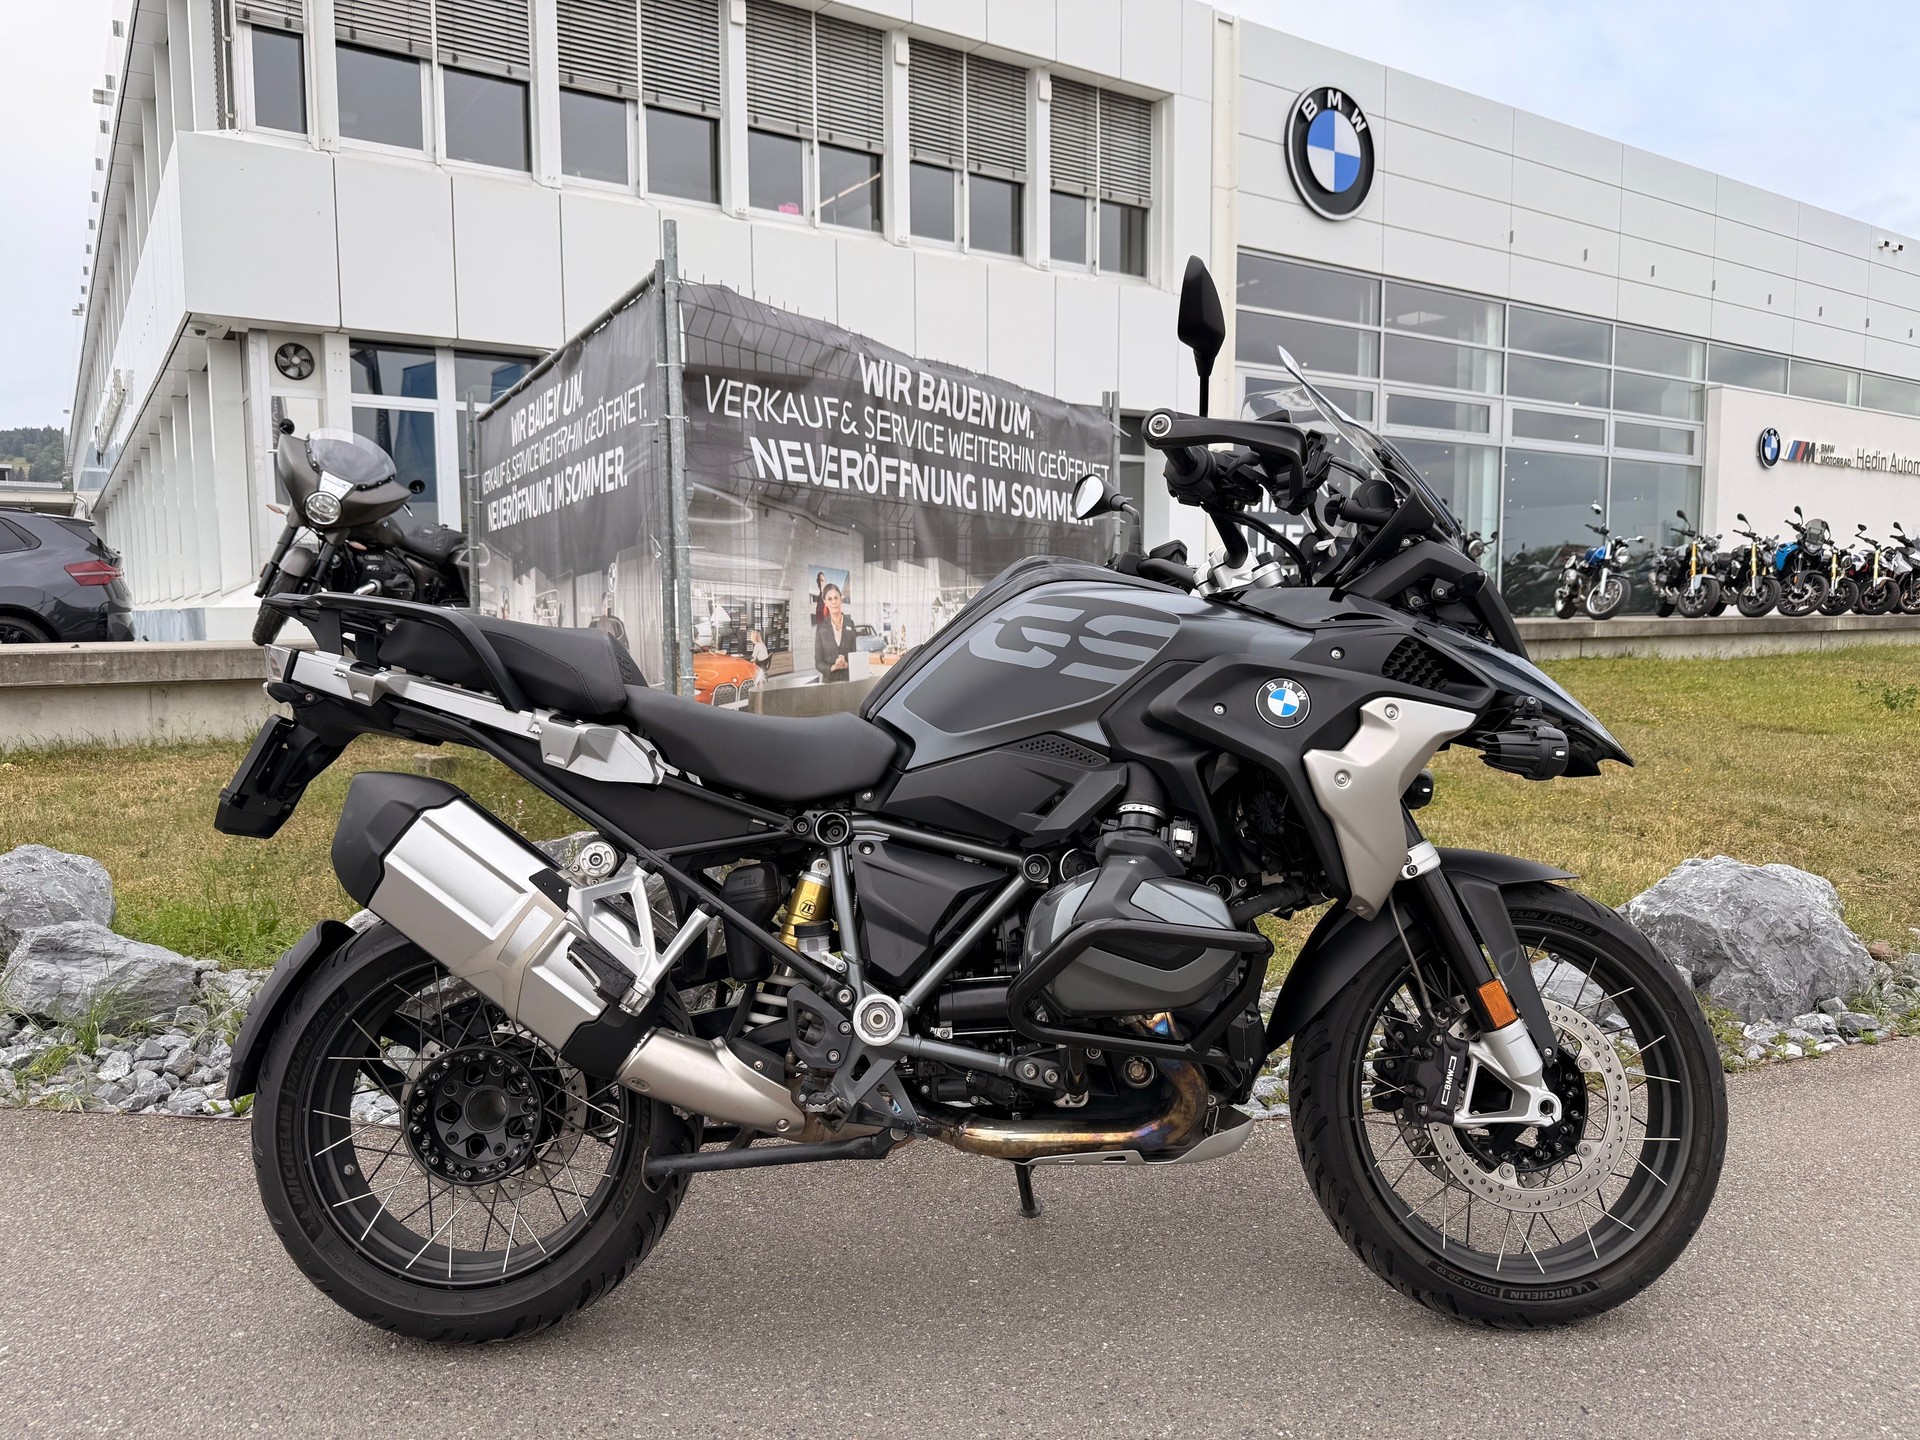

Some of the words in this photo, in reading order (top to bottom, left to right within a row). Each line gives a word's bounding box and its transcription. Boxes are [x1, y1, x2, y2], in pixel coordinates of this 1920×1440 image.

[1301, 89, 1367, 133] BMW
[511, 408, 526, 447] WIR
[528, 383, 562, 437] BAUEN
[563, 370, 584, 416] UM.
[859, 352, 912, 406] WIR
[918, 371, 996, 429] BAUEN
[1000, 398, 1035, 439] UM.
[506, 458, 511, 484] &
[512, 443, 539, 481] SERVICE
[539, 417, 583, 467] WEITERHIN
[584, 382, 647, 445] GEÖFFNET.
[705, 375, 839, 429] VERKAUF
[840, 401, 859, 435] &
[864, 406, 945, 456] SERVICE
[948, 427, 1035, 475] WEITERHIN
[1820, 443, 1836, 454] BMW
[1820, 455, 1852, 468] MOTORRAD
[1856, 447, 1887, 472] Hedin
[487, 476, 552, 533] NEUERÖFFNUNG
[565, 445, 628, 503] SOMMER.
[750, 436, 978, 511] NEUERÖFFNUNG
[982, 477, 1007, 514] IM
[968, 602, 1181, 686] GS
[1266, 681, 1307, 701] BMW
[801, 902, 816, 915] ZF
[1551, 915, 1584, 930] ROAD
[1444, 1068, 1456, 1091] BMW
[279, 1103, 306, 1205] MICHELIN
[1463, 1279, 1498, 1296] 120/70
[1510, 1287, 1573, 1299] MICHELIN
